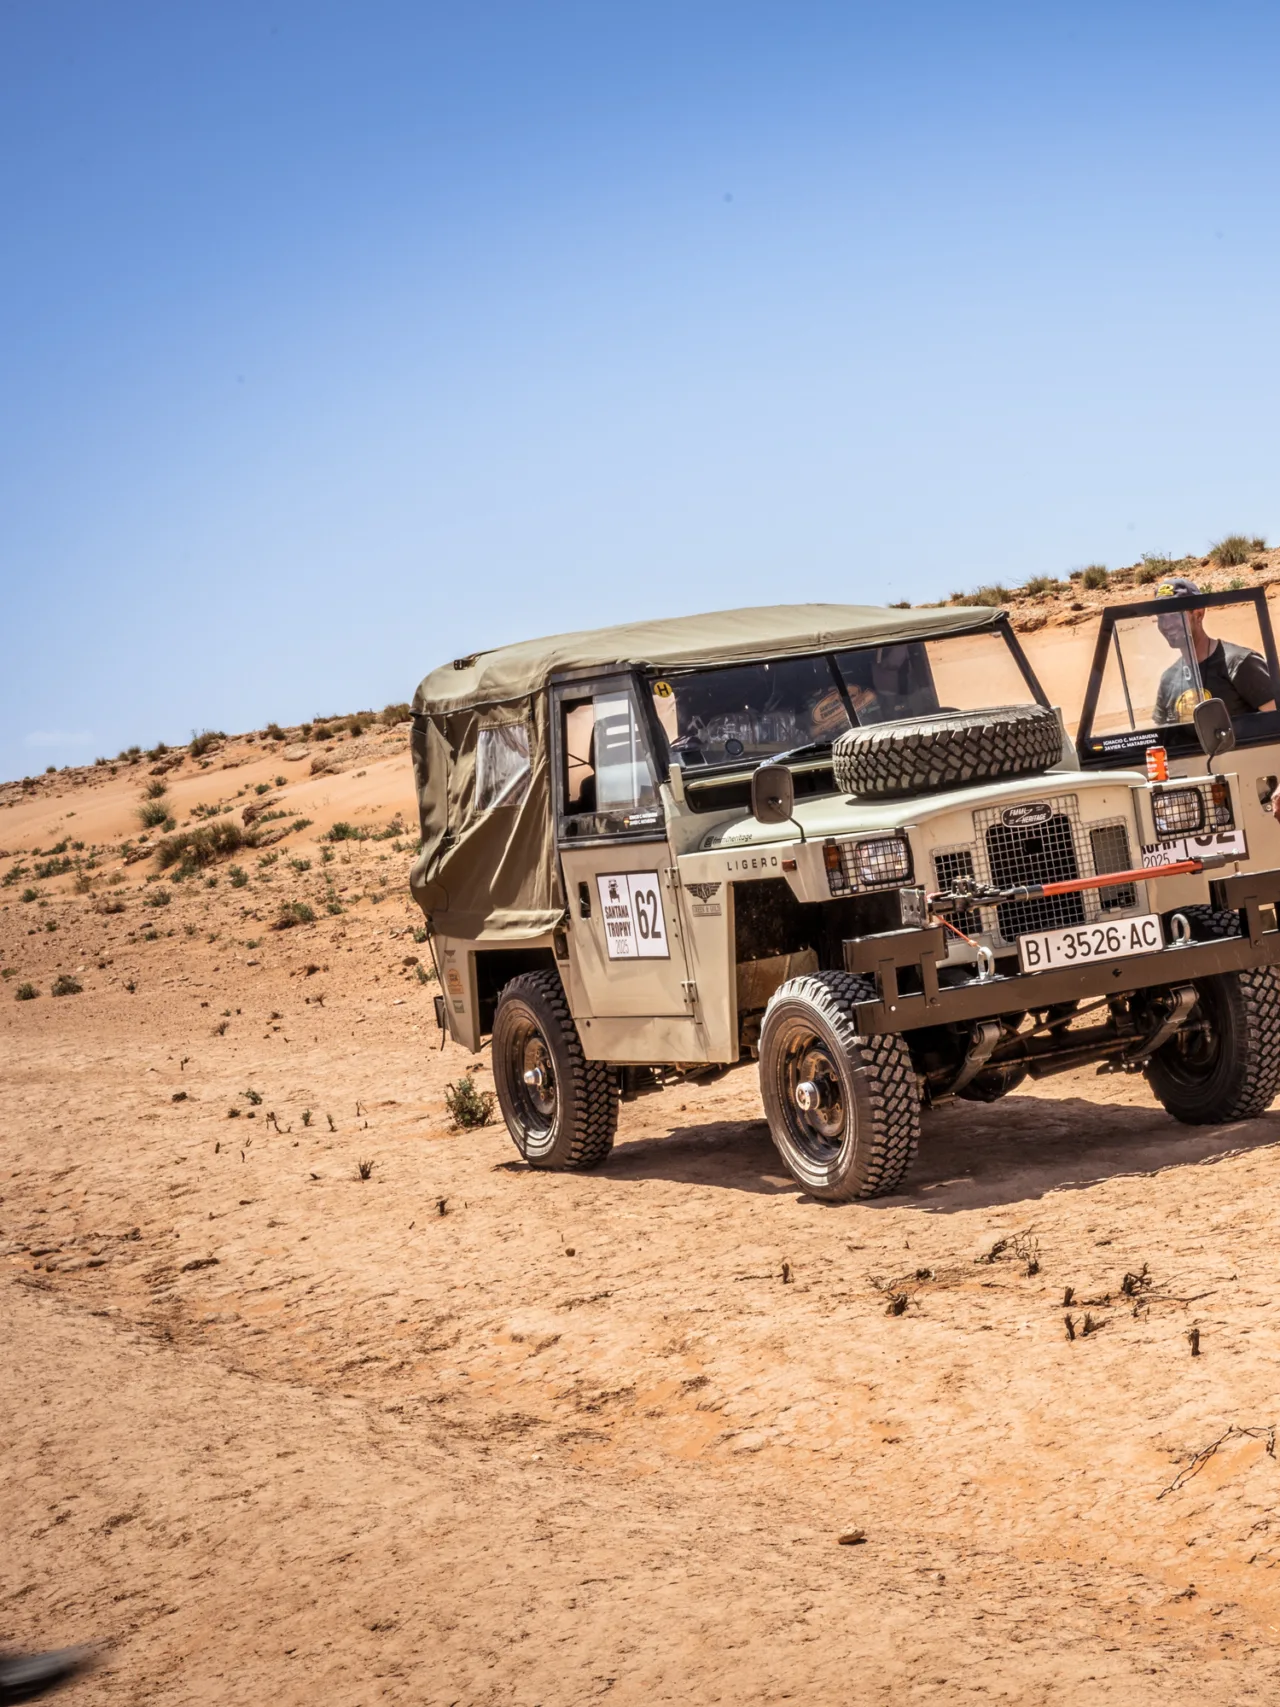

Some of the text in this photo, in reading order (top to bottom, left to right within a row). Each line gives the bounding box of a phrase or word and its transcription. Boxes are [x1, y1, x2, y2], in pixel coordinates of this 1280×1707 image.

[656, 683, 670, 696] H
[726, 856, 778, 871] LIGERO
[604, 905, 630, 919] SANTANA
[635, 889, 662, 940] 62
[607, 921, 632, 938] TROPHY
